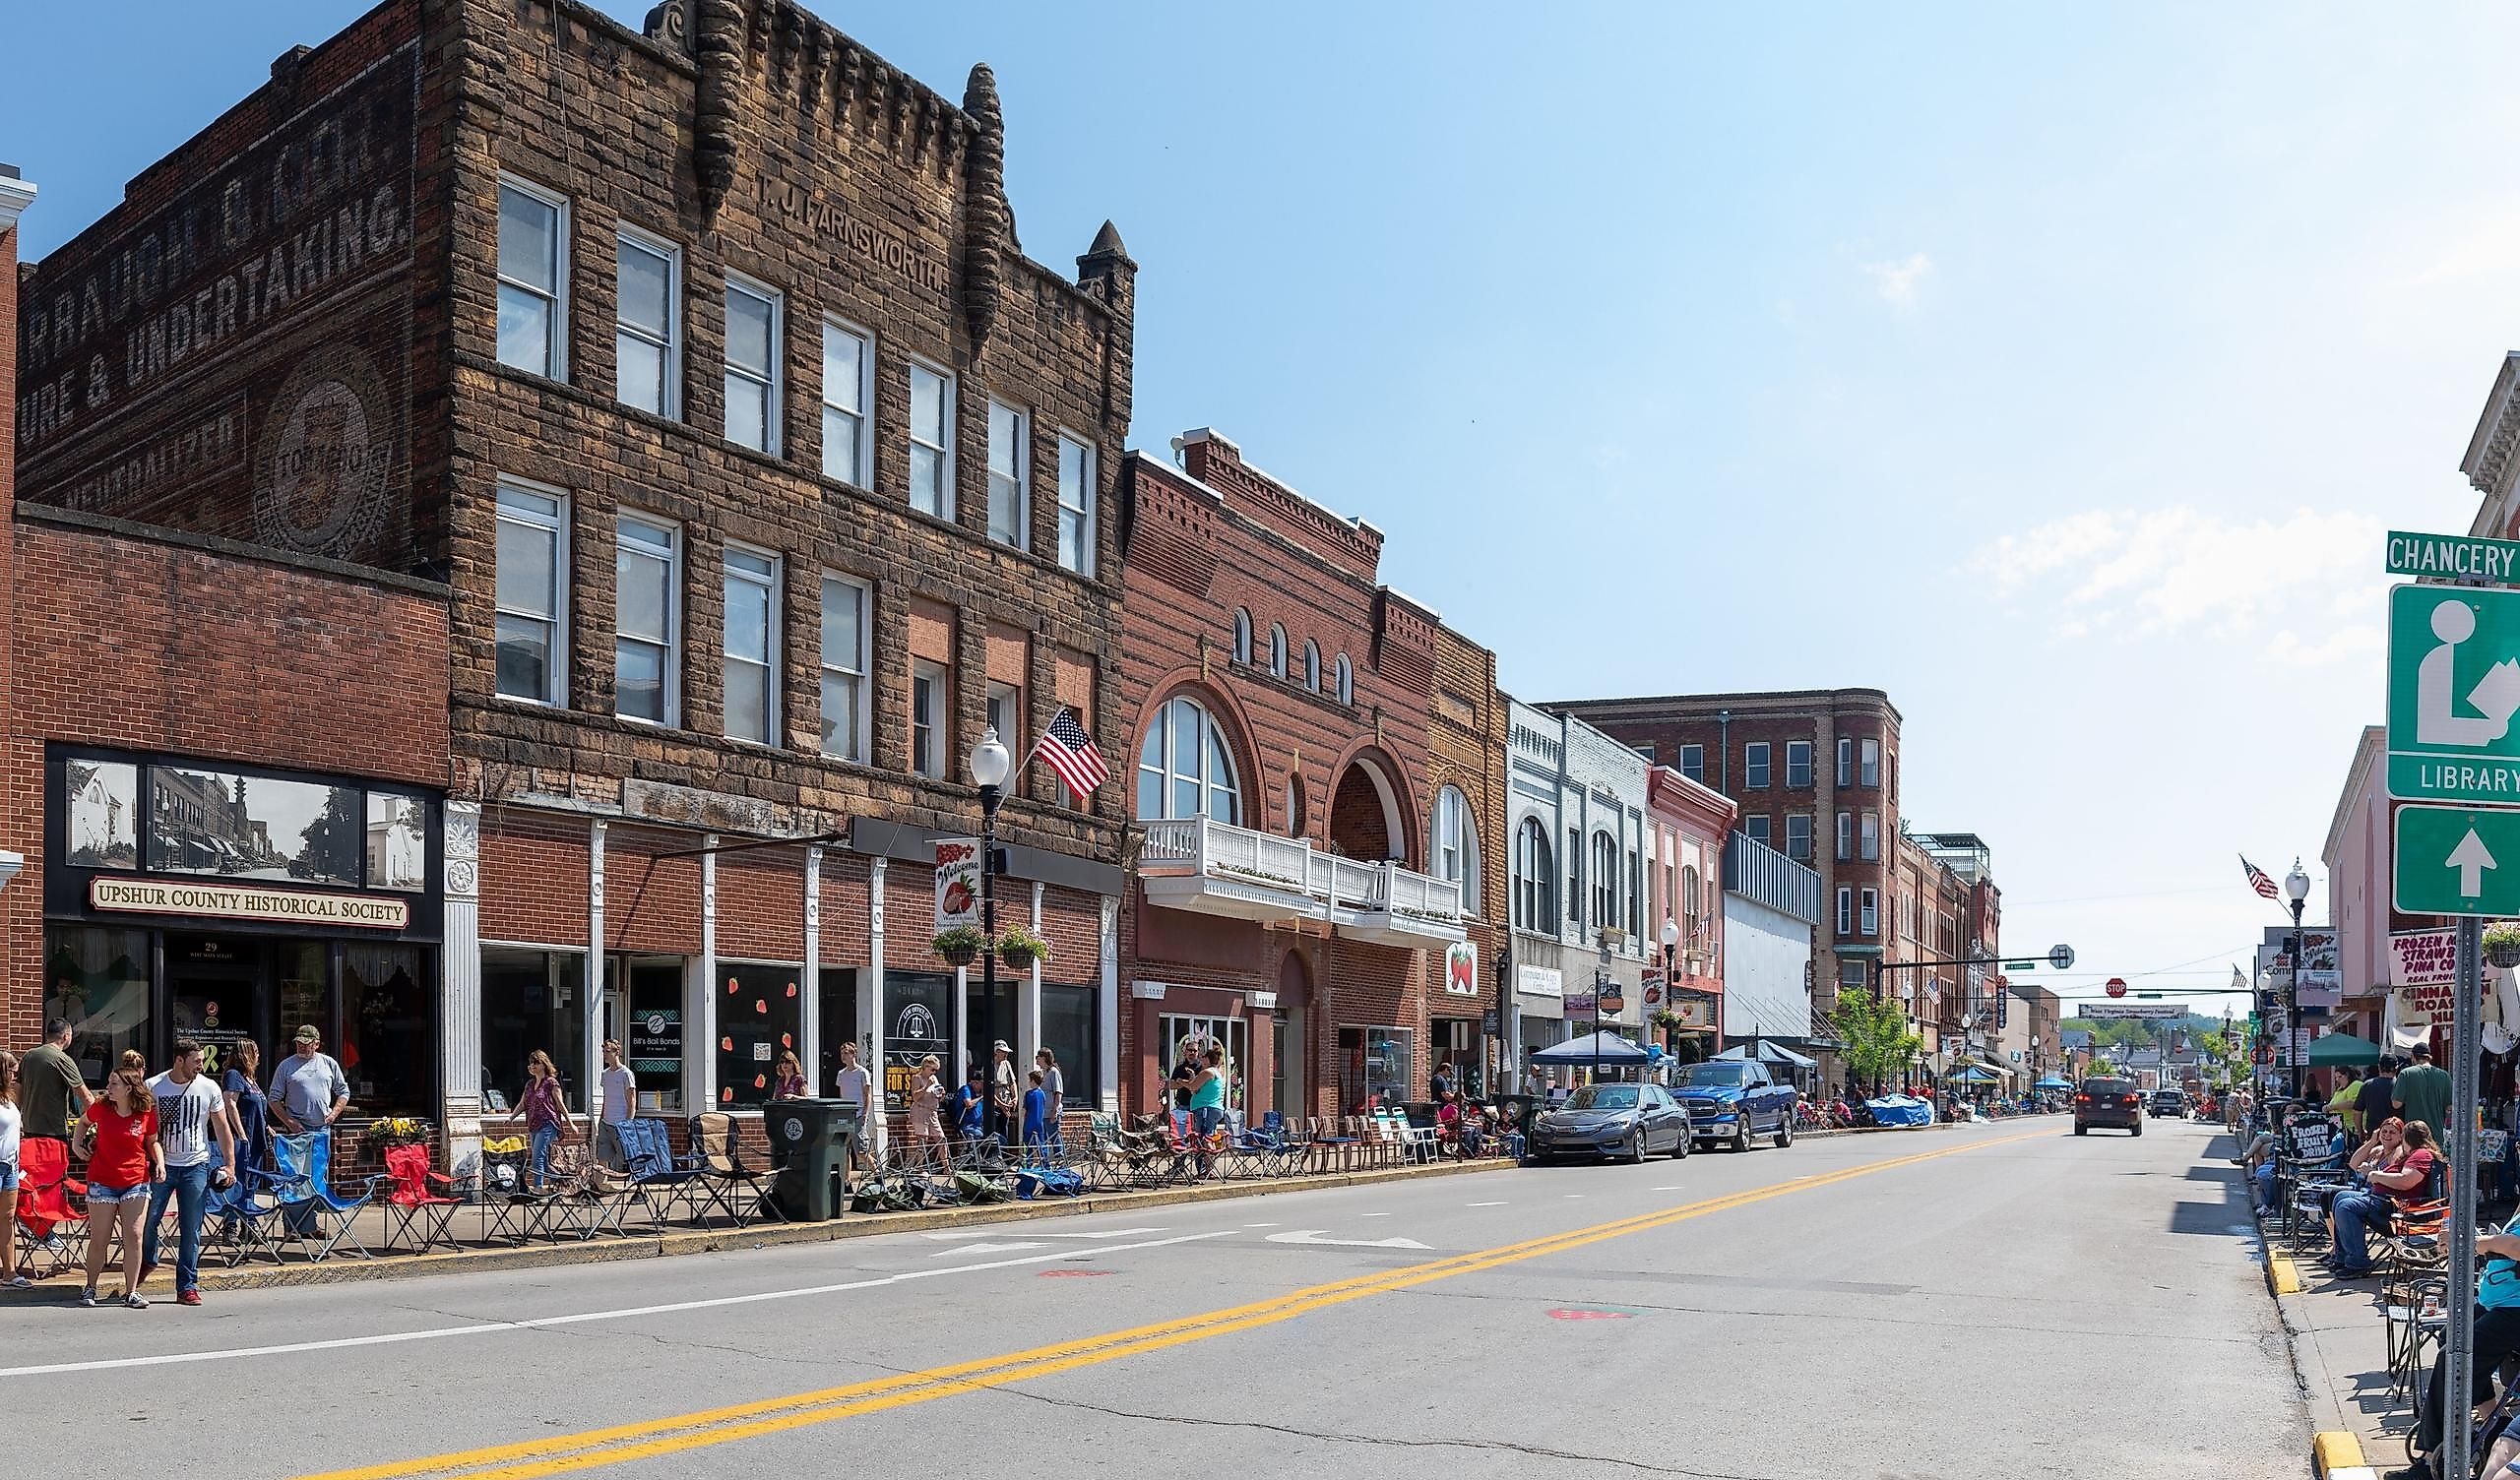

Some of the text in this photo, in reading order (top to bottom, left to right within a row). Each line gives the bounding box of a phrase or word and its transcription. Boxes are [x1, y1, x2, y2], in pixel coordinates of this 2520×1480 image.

[2387, 537, 2516, 577] CHANCERY
[2421, 764, 2520, 793] LIBRARY
[937, 861, 979, 889] Welcome
[97, 884, 404, 922] UPSHUR COUNTY HISTORICAL SOCIETY
[205, 942, 218, 953] 29
[2392, 935, 2444, 952] FROZEN
[2401, 946, 2456, 962] STRAWB
[2404, 960, 2435, 974] PINA
[2107, 984, 2125, 993] STOP
[887, 1074, 902, 1091] FOR
[2291, 1123, 2329, 1139] FROZEN
